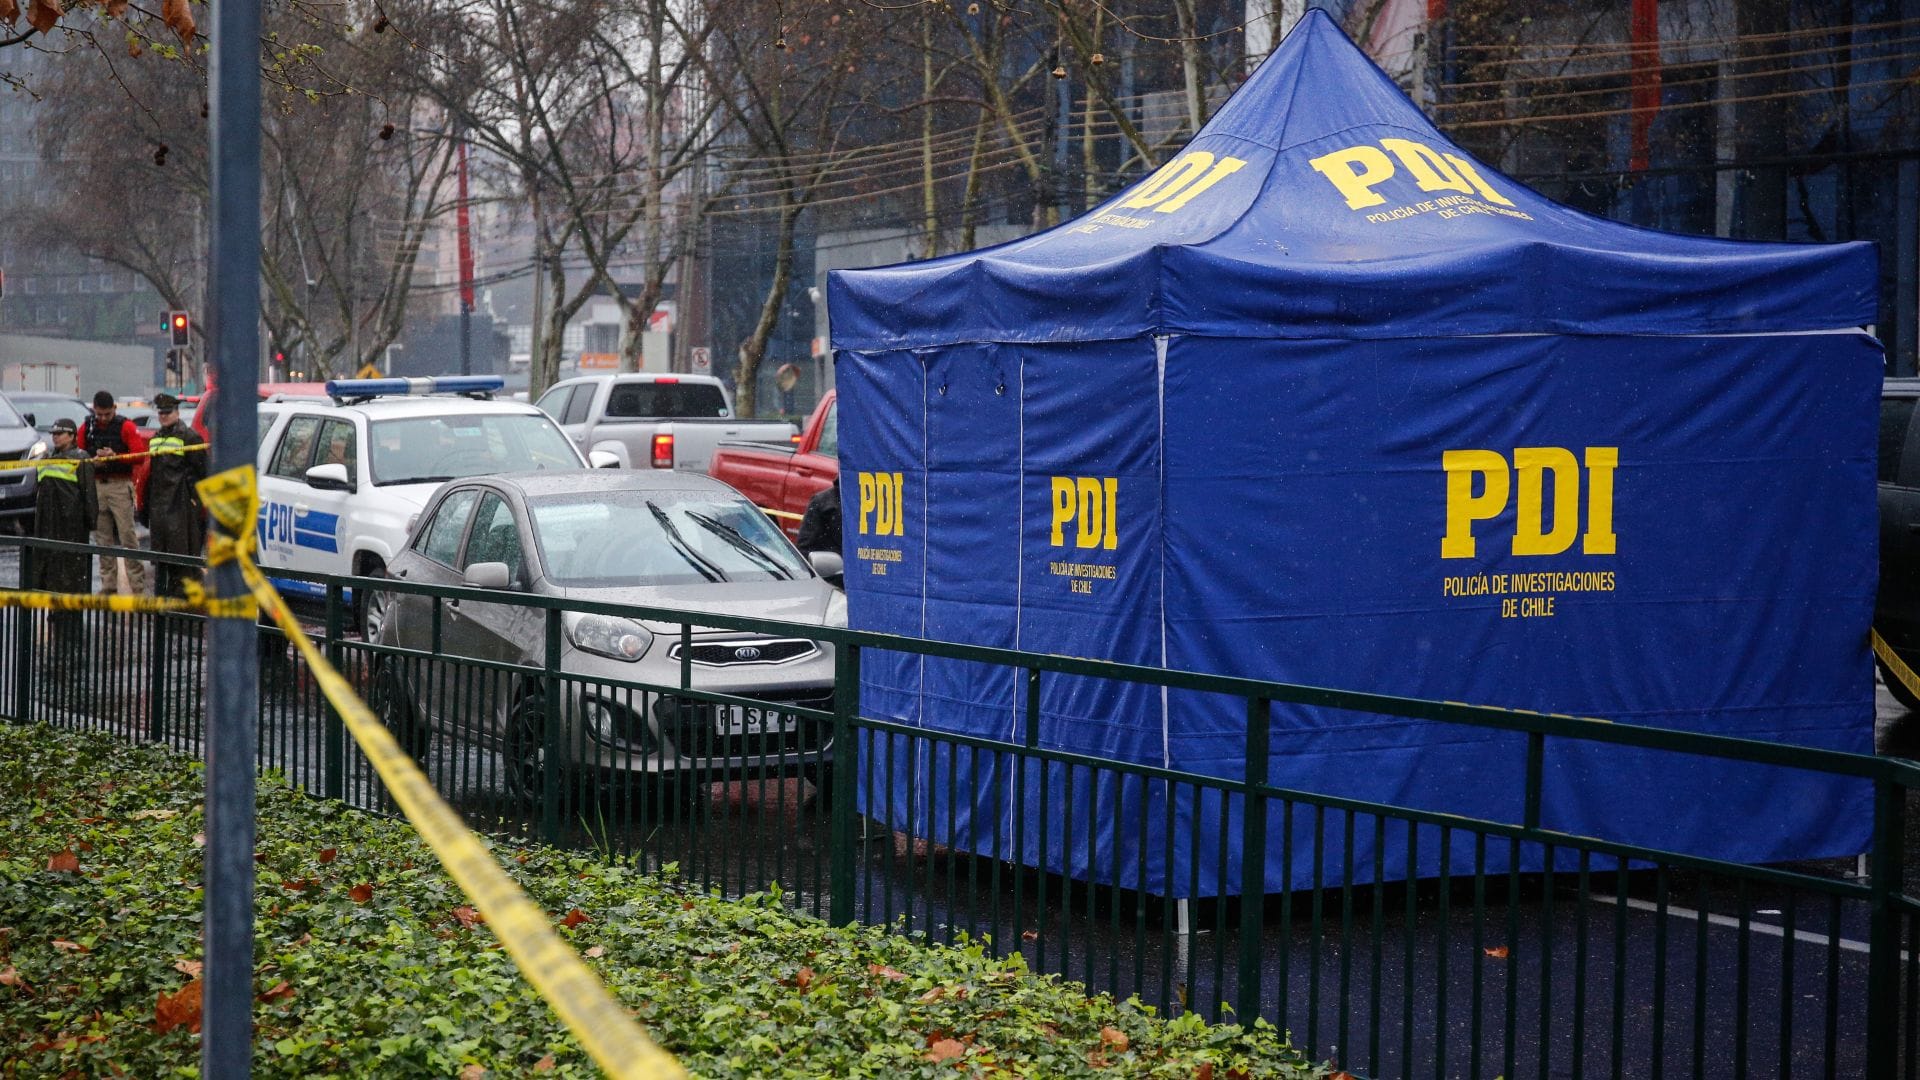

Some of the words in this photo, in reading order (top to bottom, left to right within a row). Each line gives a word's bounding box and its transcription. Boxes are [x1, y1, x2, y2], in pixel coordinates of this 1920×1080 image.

[1090, 151, 1248, 220] DI
[1308, 138, 1517, 210] PDI
[1366, 207, 1419, 224] POLICÍA
[1416, 201, 1438, 213] DE
[1438, 208, 1461, 220] DE
[268, 502, 293, 544] PDI
[858, 471, 904, 536] PDI
[1050, 476, 1118, 550] PDI
[1441, 446, 1618, 559] PDI
[1444, 571, 1489, 597] POLICÍA
[1492, 574, 1508, 594] DE
[1511, 571, 1615, 594] INVESTIGACIONES
[1501, 598, 1517, 618] DE
[1521, 597, 1555, 618] CHILE
[739, 646, 757, 657] KIA
